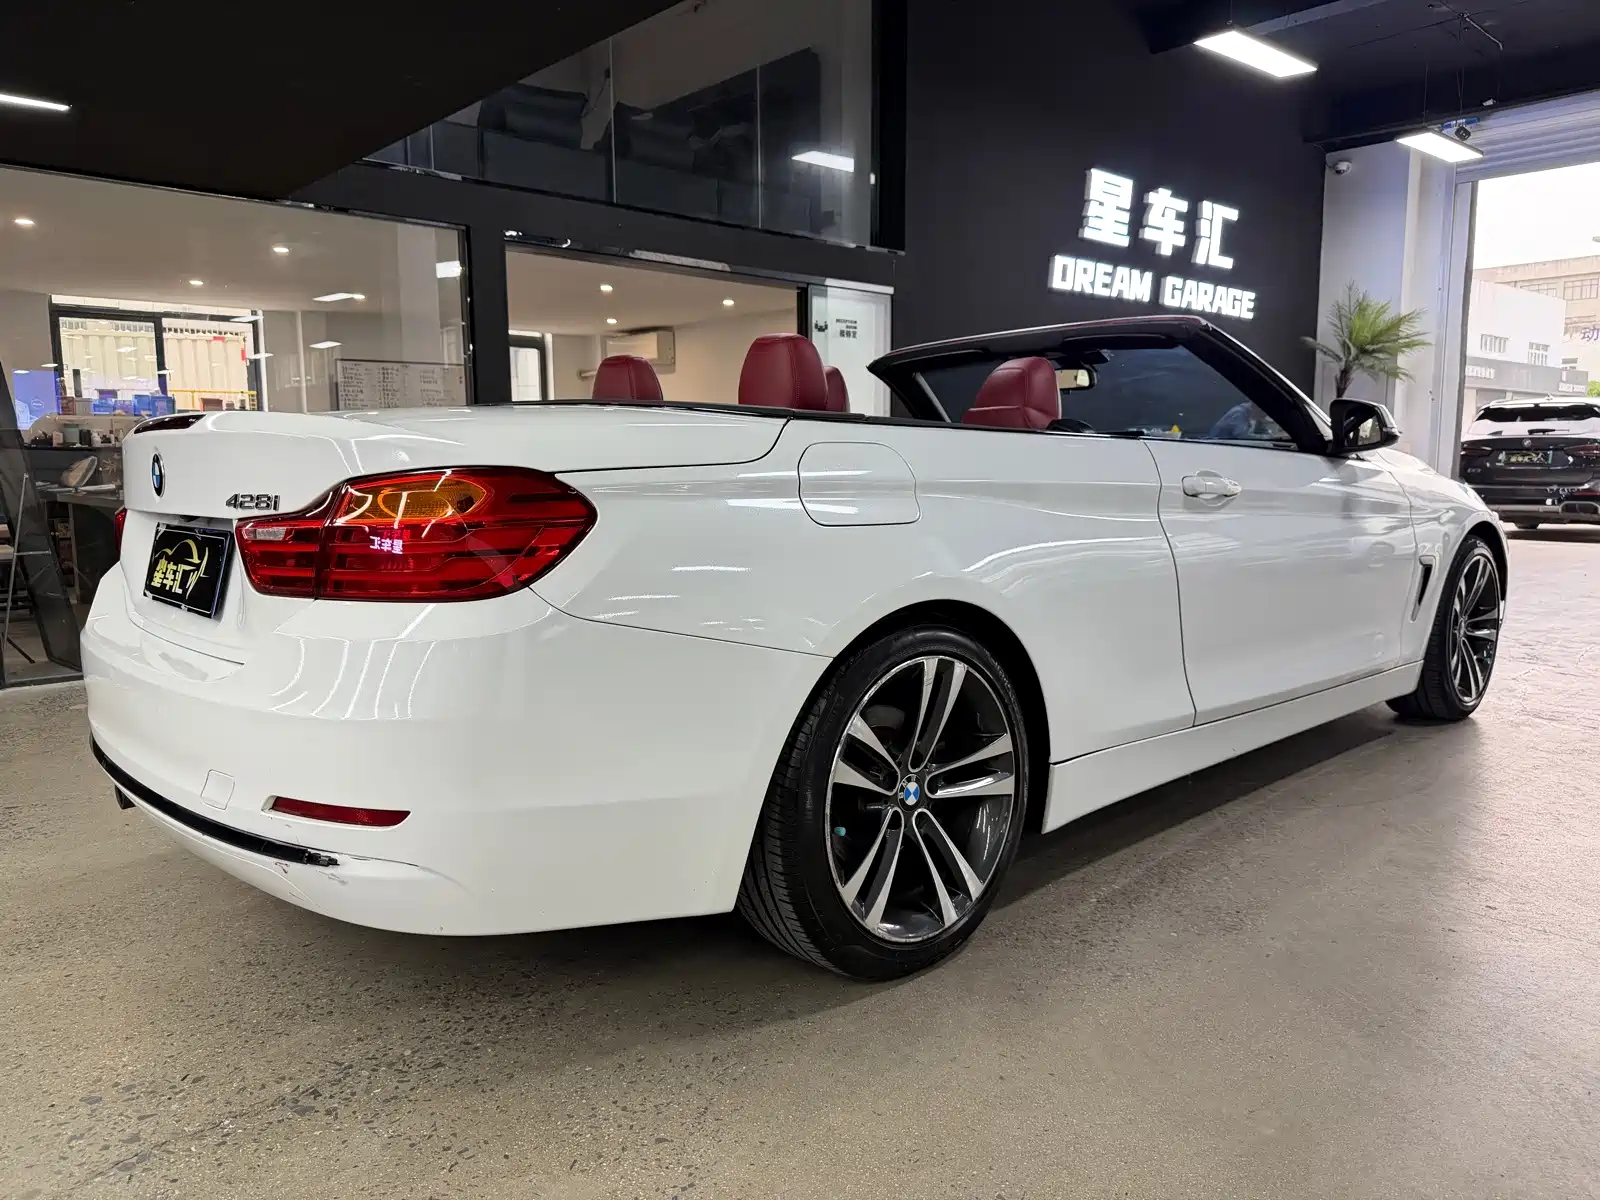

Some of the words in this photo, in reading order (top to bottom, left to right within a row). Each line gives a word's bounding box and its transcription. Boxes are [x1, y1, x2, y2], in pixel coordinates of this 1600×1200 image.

[1079, 168, 1239, 269] 星车汇
[1049, 254, 1153, 302] DREAM
[1159, 275, 1256, 320] GARAGE
[225, 493, 280, 511] 428i
[151, 557, 197, 595] 星车汇
